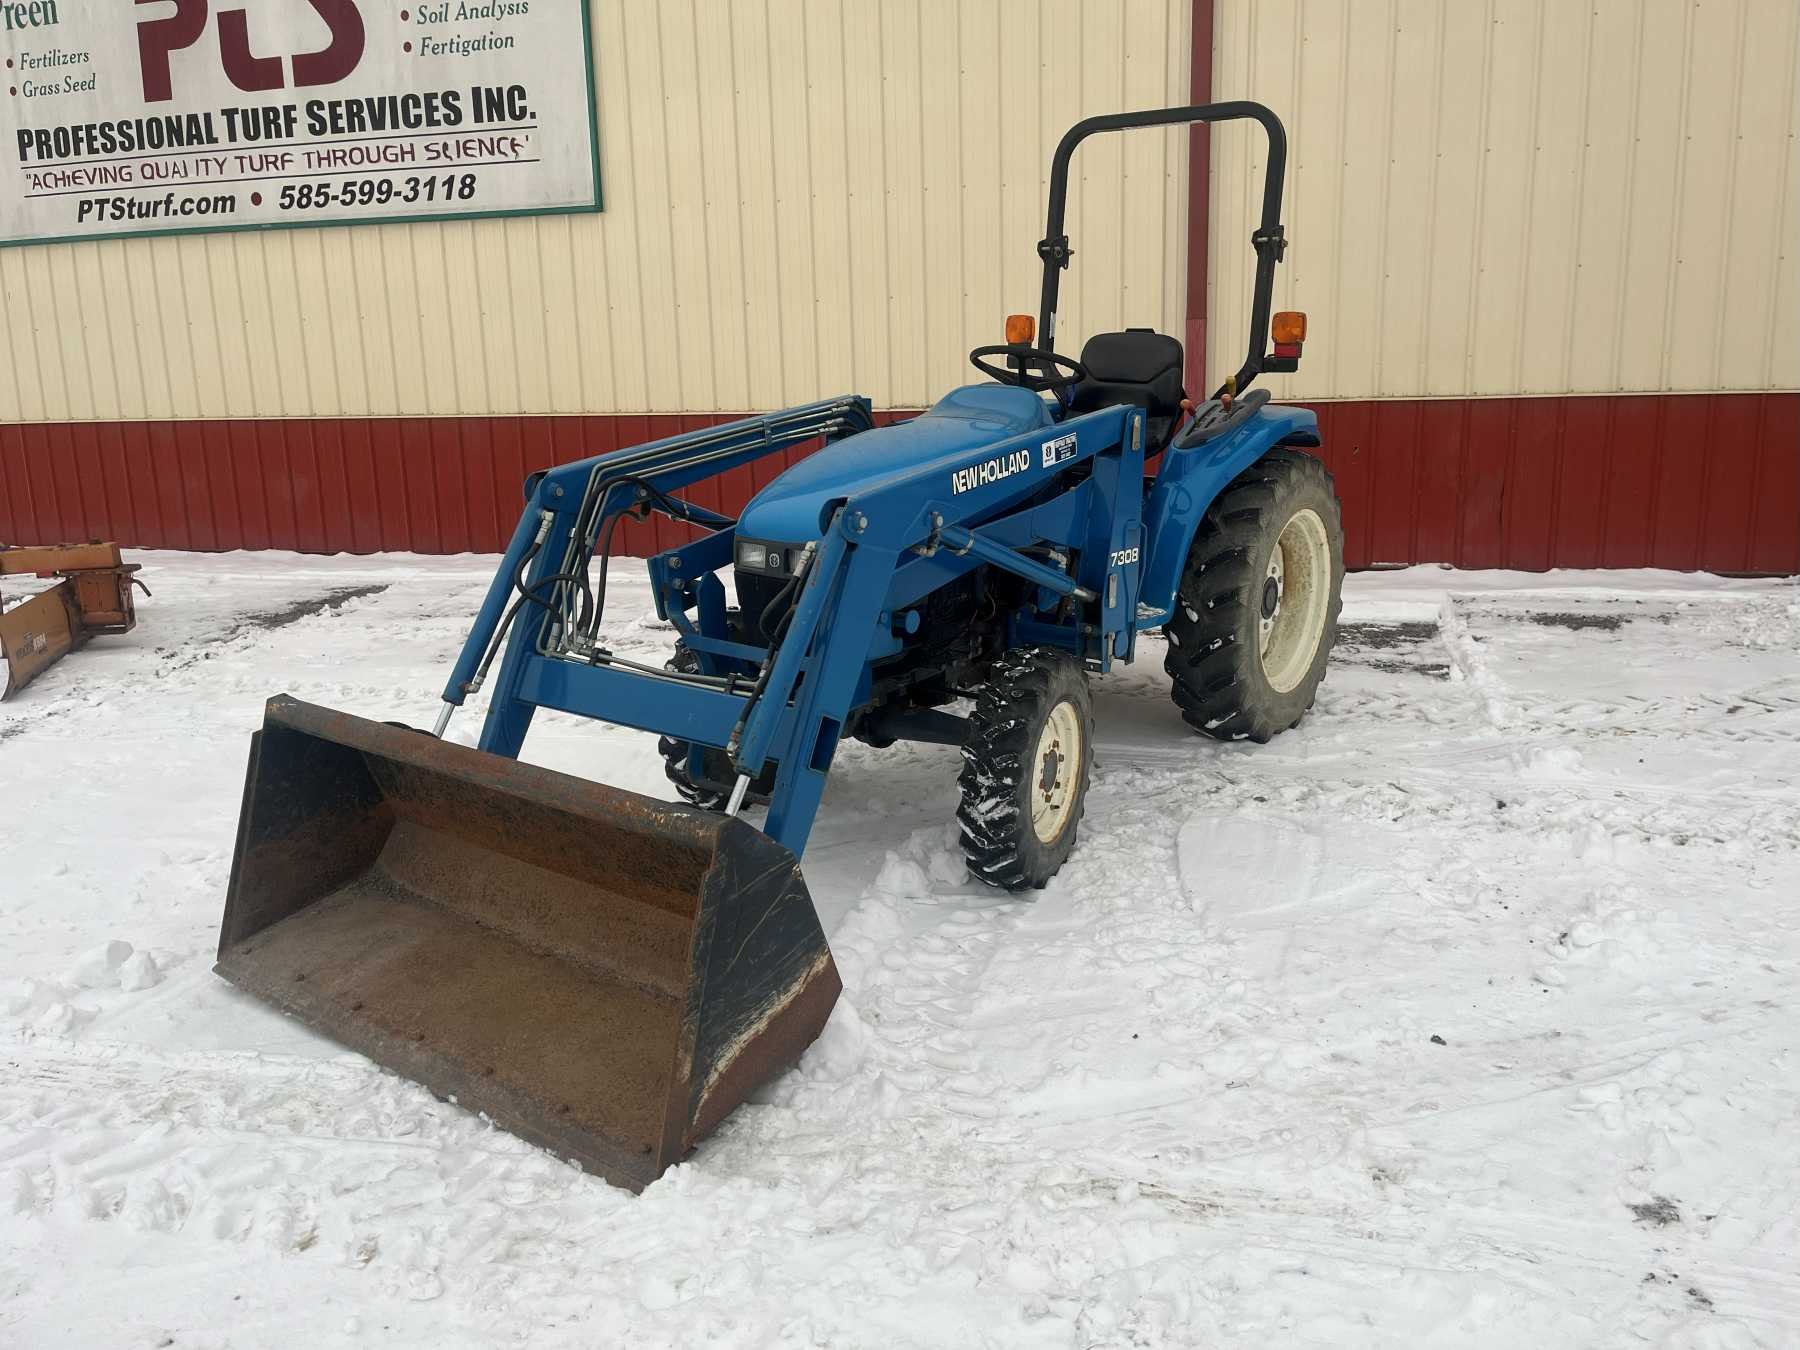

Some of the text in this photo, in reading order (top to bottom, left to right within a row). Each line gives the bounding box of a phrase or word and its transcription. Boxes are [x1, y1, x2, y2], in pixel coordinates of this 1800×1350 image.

[0, 0, 60, 30] reen
[417, 0, 529, 25] Soil Analysis
[420, 31, 514, 57] Fertigation
[20, 49, 89, 71] Fertilizers
[23, 73, 96, 98] Grass Seed
[16, 84, 537, 161] PROFESSIONAL TURF SERVICES INC.
[234, 152, 294, 173] TURF
[302, 142, 415, 170] THROUGH
[77, 173, 477, 223] PTSturf.com 585-599-3118
[952, 449, 1030, 496] NEW HOLLAND
[1111, 548, 1140, 568] 7308
